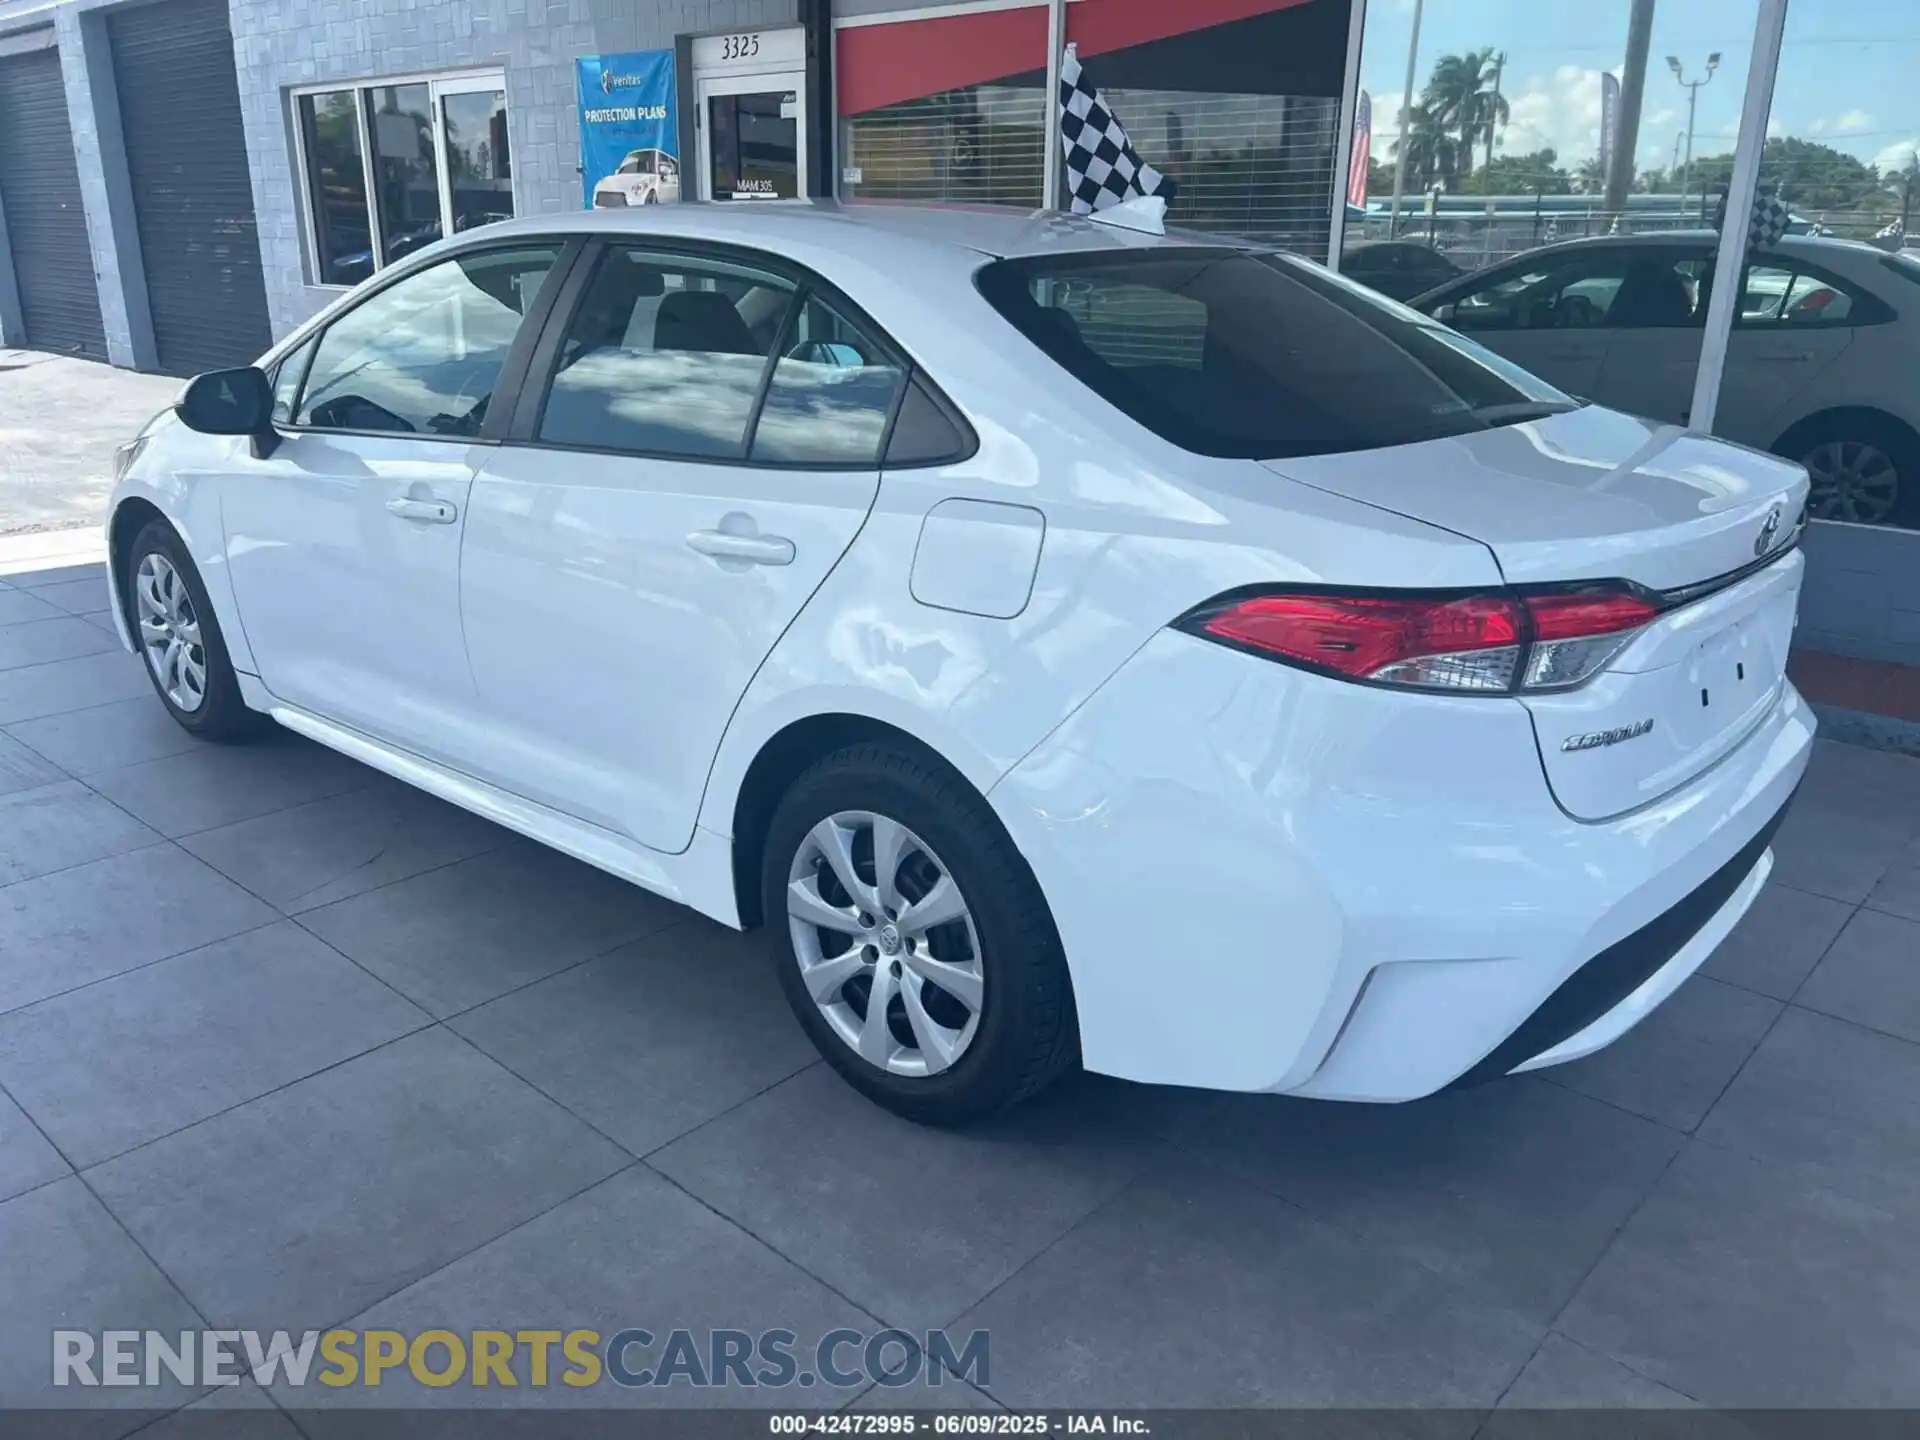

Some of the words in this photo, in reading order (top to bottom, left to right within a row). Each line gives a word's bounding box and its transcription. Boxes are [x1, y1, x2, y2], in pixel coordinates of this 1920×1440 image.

[721, 34, 760, 60] 3325
[584, 107, 636, 123] PROTECTION
[638, 104, 667, 120] PLANS
